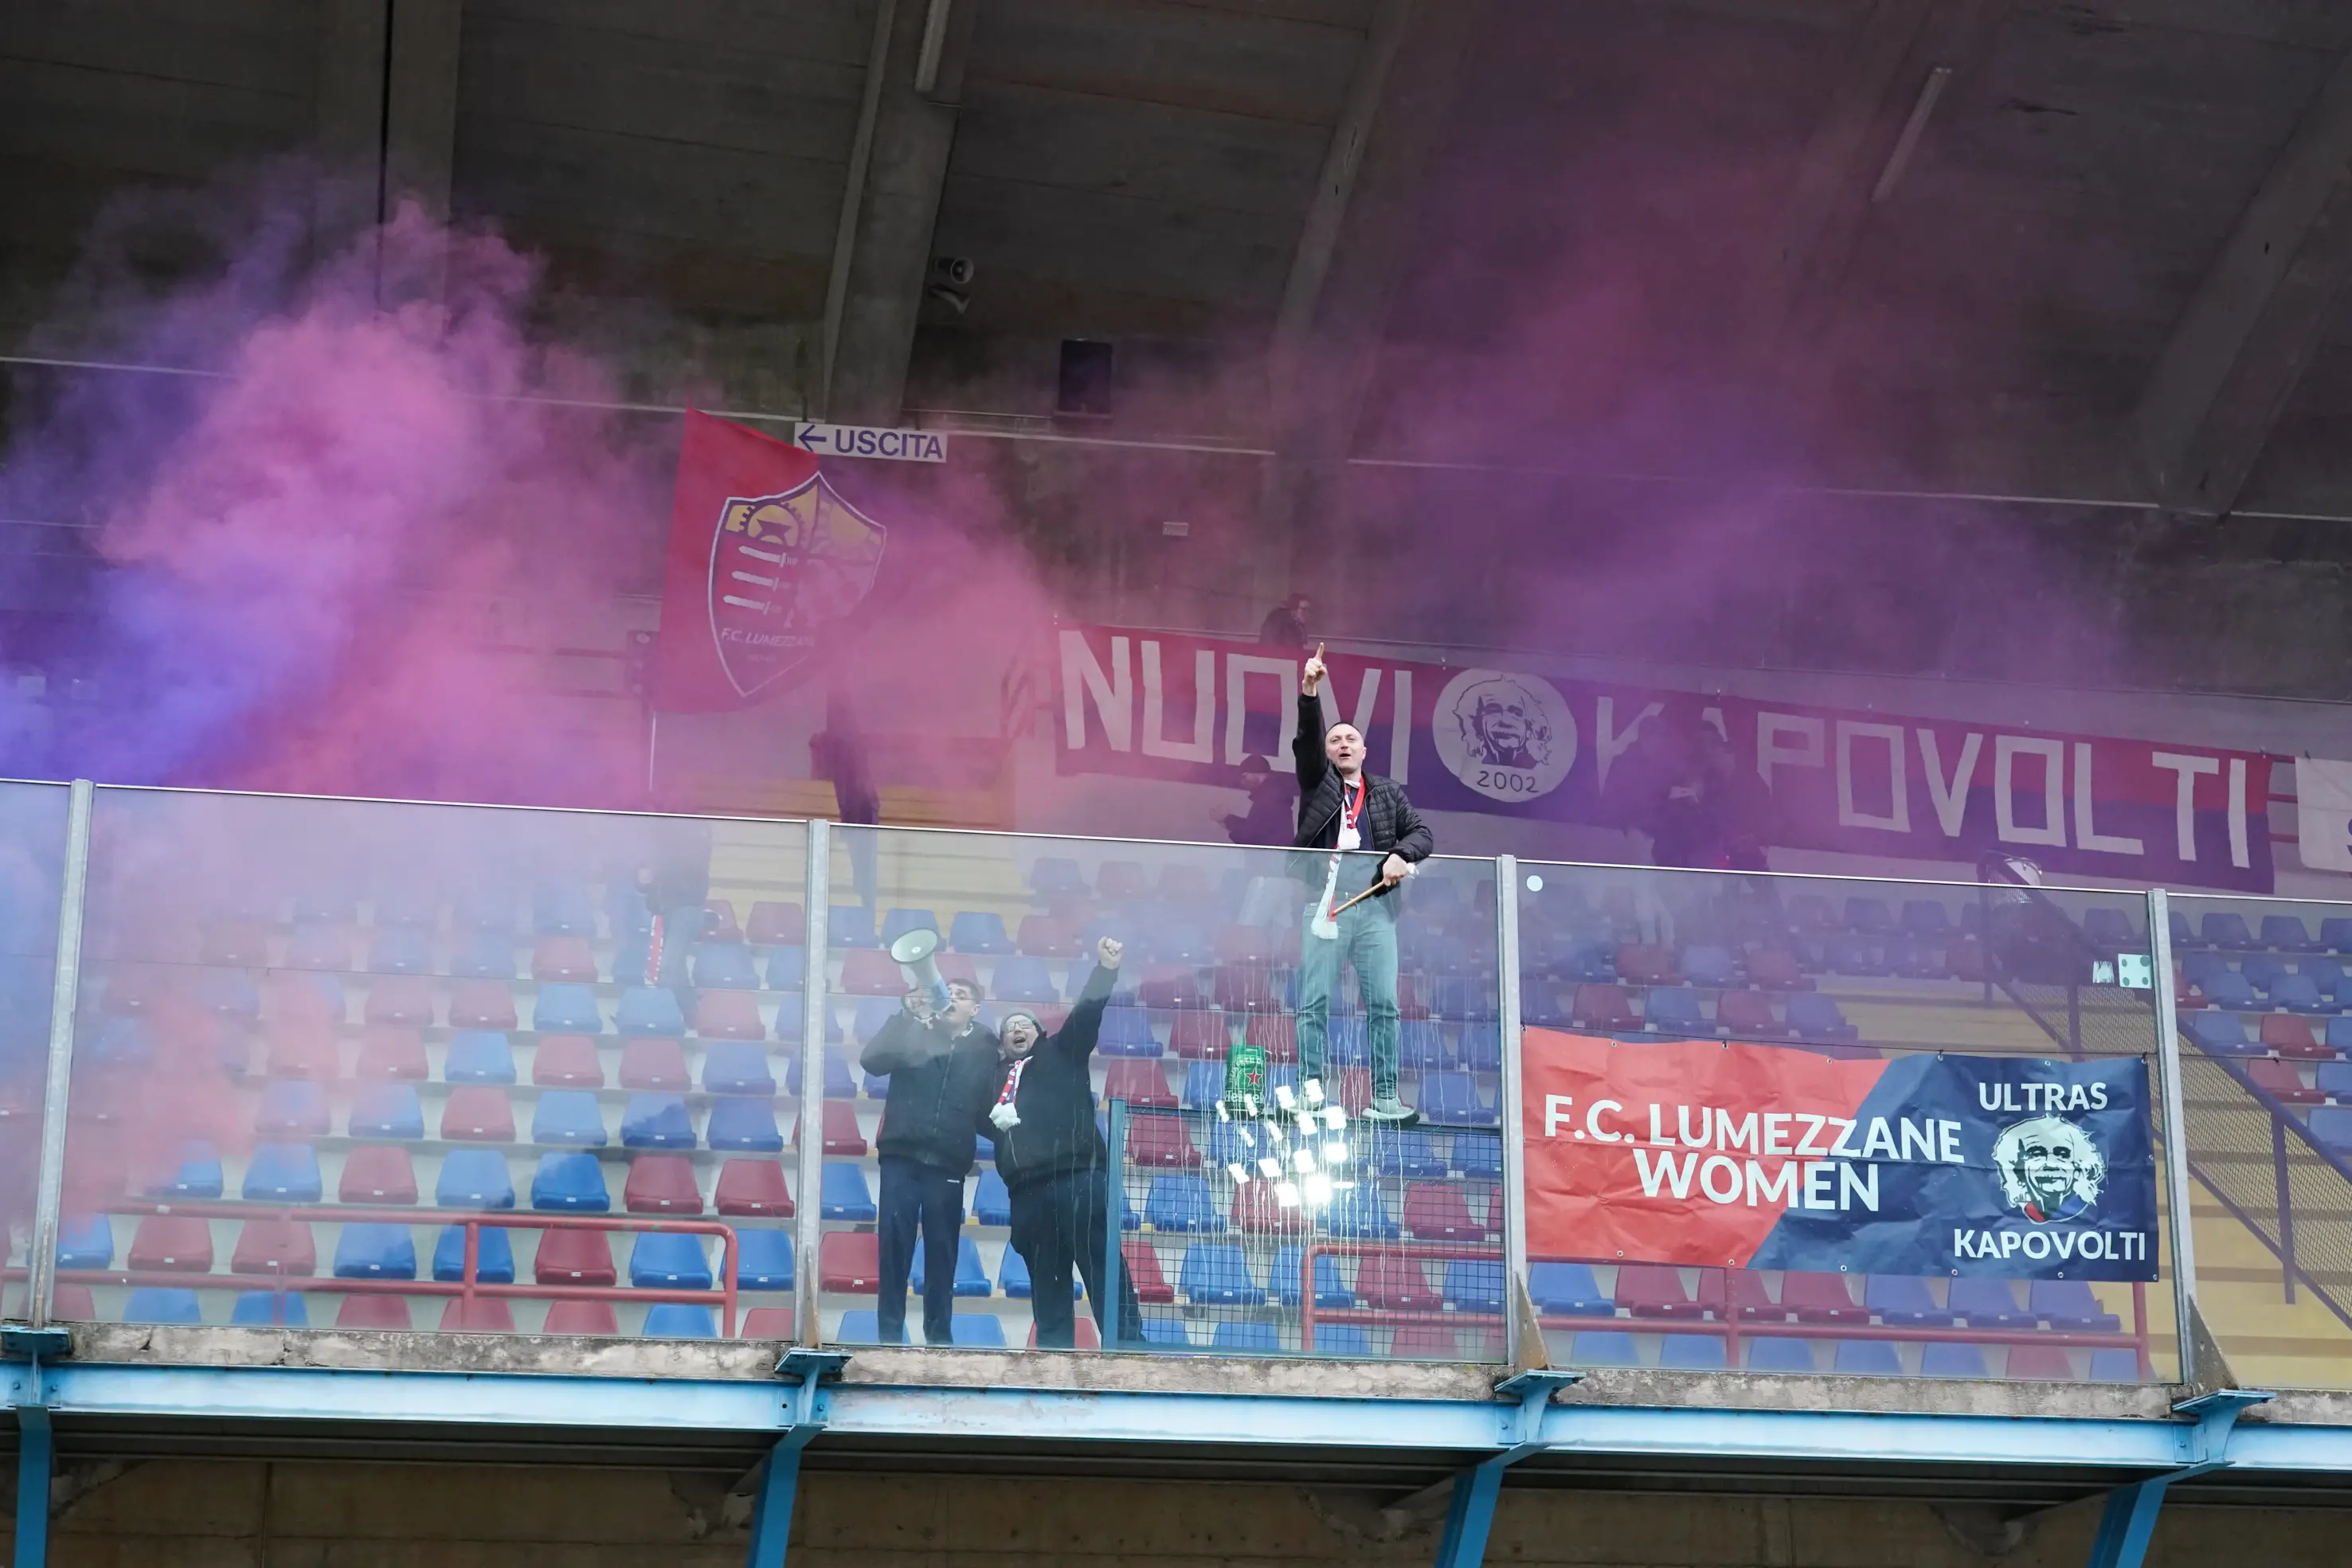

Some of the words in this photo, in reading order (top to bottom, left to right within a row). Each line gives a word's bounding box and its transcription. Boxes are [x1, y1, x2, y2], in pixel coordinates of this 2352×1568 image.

[835, 429, 943, 459] USCITA
[1477, 769, 1540, 794] 2002
[1978, 1081, 2108, 1112] ULTRAS
[1544, 1093, 1634, 1144] F.C.
[1649, 1103, 1965, 1163] LUMEZZANE
[1632, 1148, 1880, 1213] WOMEN
[1953, 1228, 2147, 1261] KAPOVOLTI
